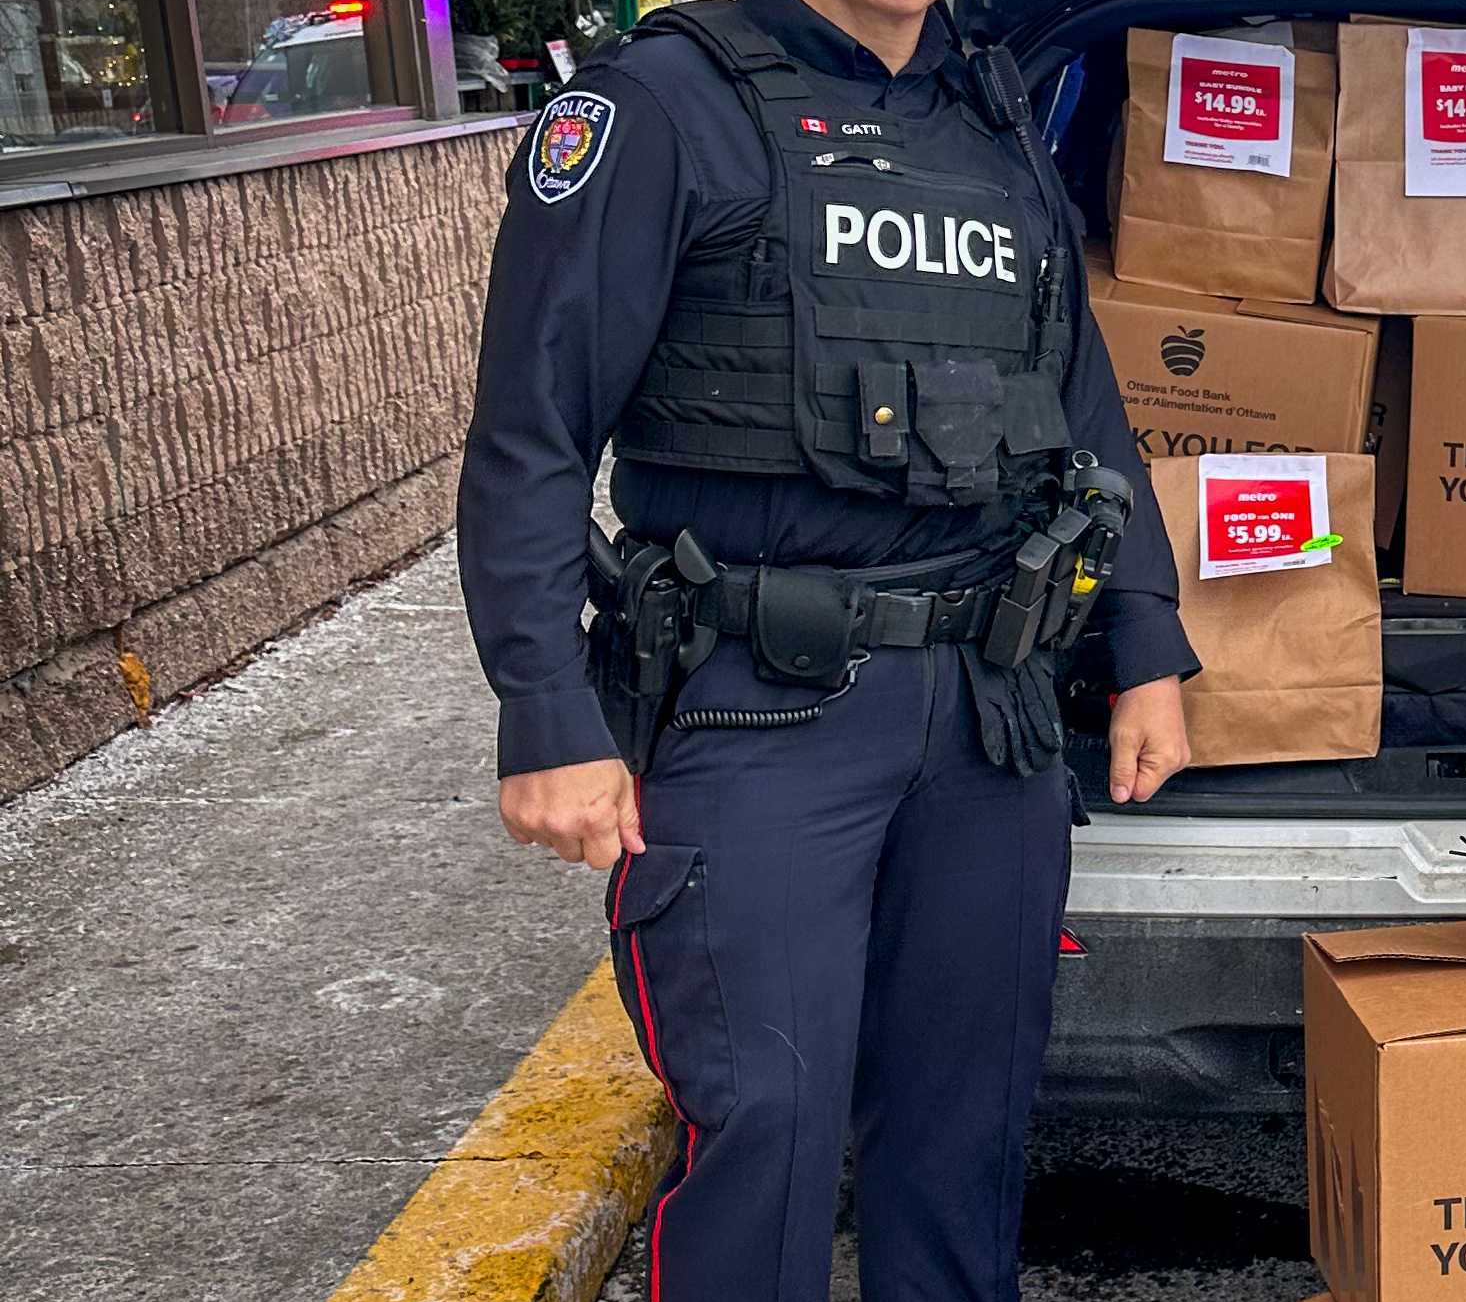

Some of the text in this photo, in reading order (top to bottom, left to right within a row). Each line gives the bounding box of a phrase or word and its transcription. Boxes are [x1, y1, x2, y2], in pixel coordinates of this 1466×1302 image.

[1212, 69, 1248, 78] metro
[1439, 84, 1464, 93] BABY
[549, 99, 605, 123] POLICE
[1194, 90, 1256, 115] $14.99
[841, 123, 883, 136] GATTI
[825, 203, 1017, 283] POLICE
[1126, 380, 1231, 402] Ottawa Food Bank
[1142, 397, 1223, 415] d'Alimentation
[1225, 406, 1276, 421] d'Ottawa
[1238, 493, 1277, 502] metro
[1223, 512, 1257, 523] FOOD
[1270, 511, 1296, 521] ONE
[1227, 524, 1282, 544] $5.99
